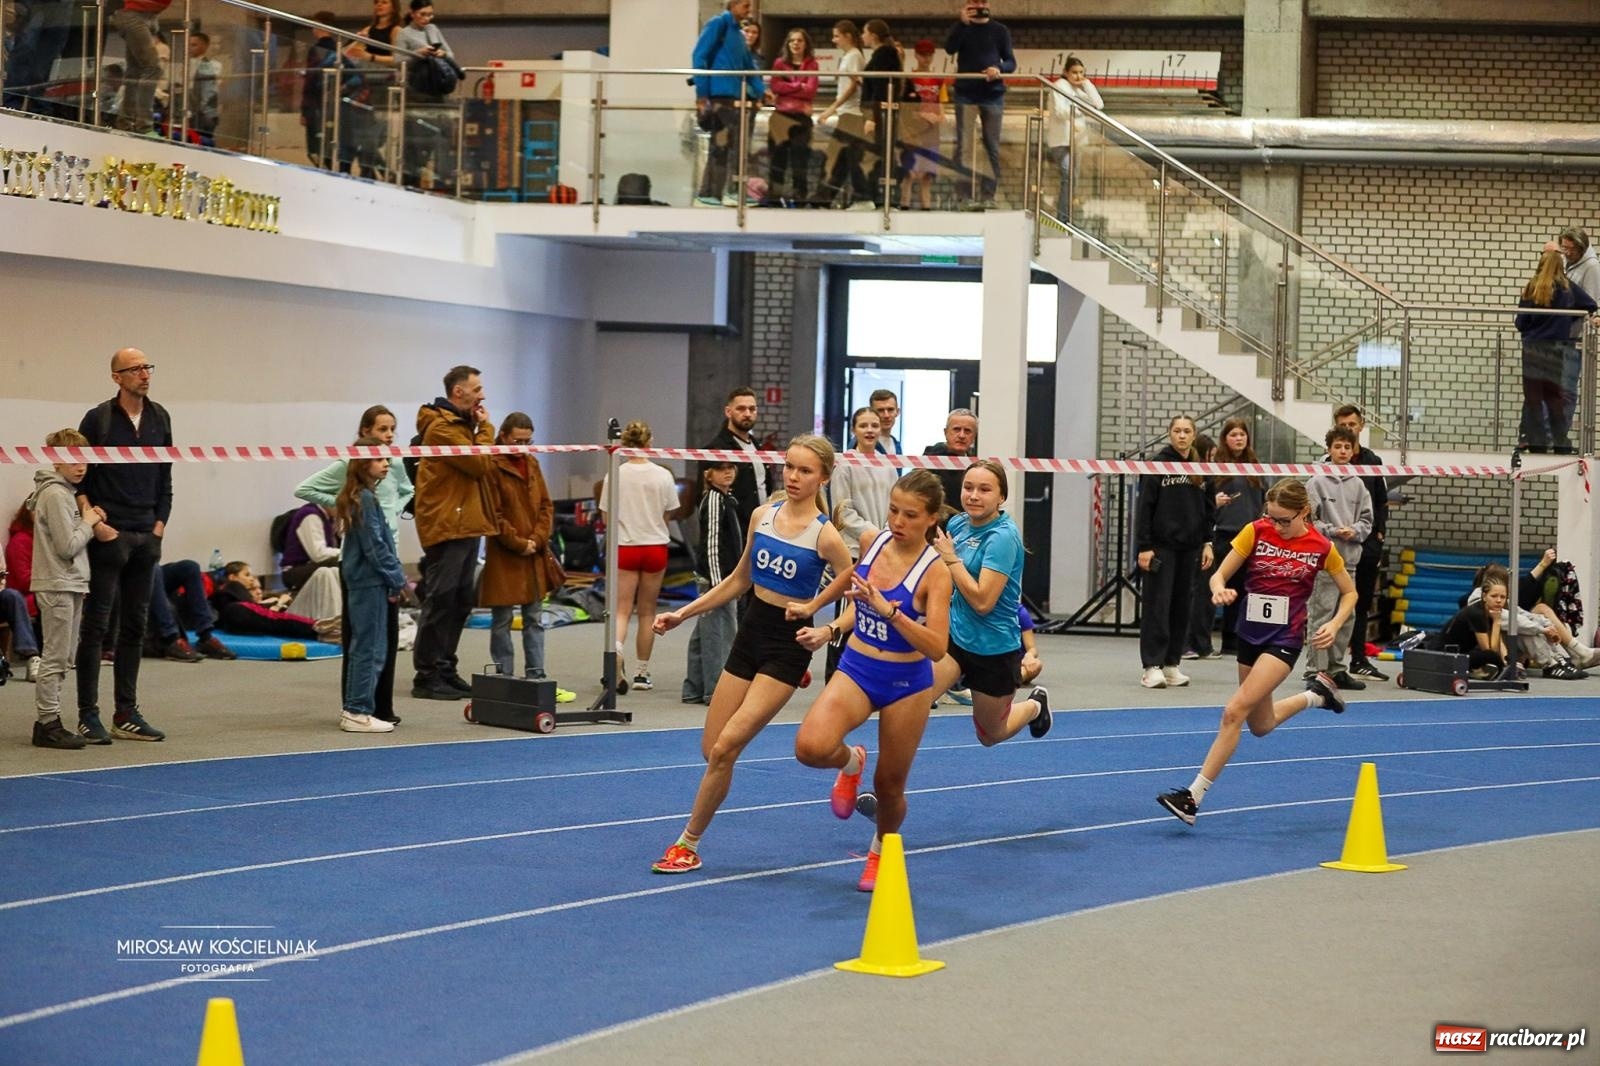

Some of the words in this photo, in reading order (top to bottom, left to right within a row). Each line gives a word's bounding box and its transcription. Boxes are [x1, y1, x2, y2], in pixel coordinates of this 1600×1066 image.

[1167, 54, 1187, 67] 17
[756, 549, 797, 579] 949
[1263, 602, 1273, 619] 6
